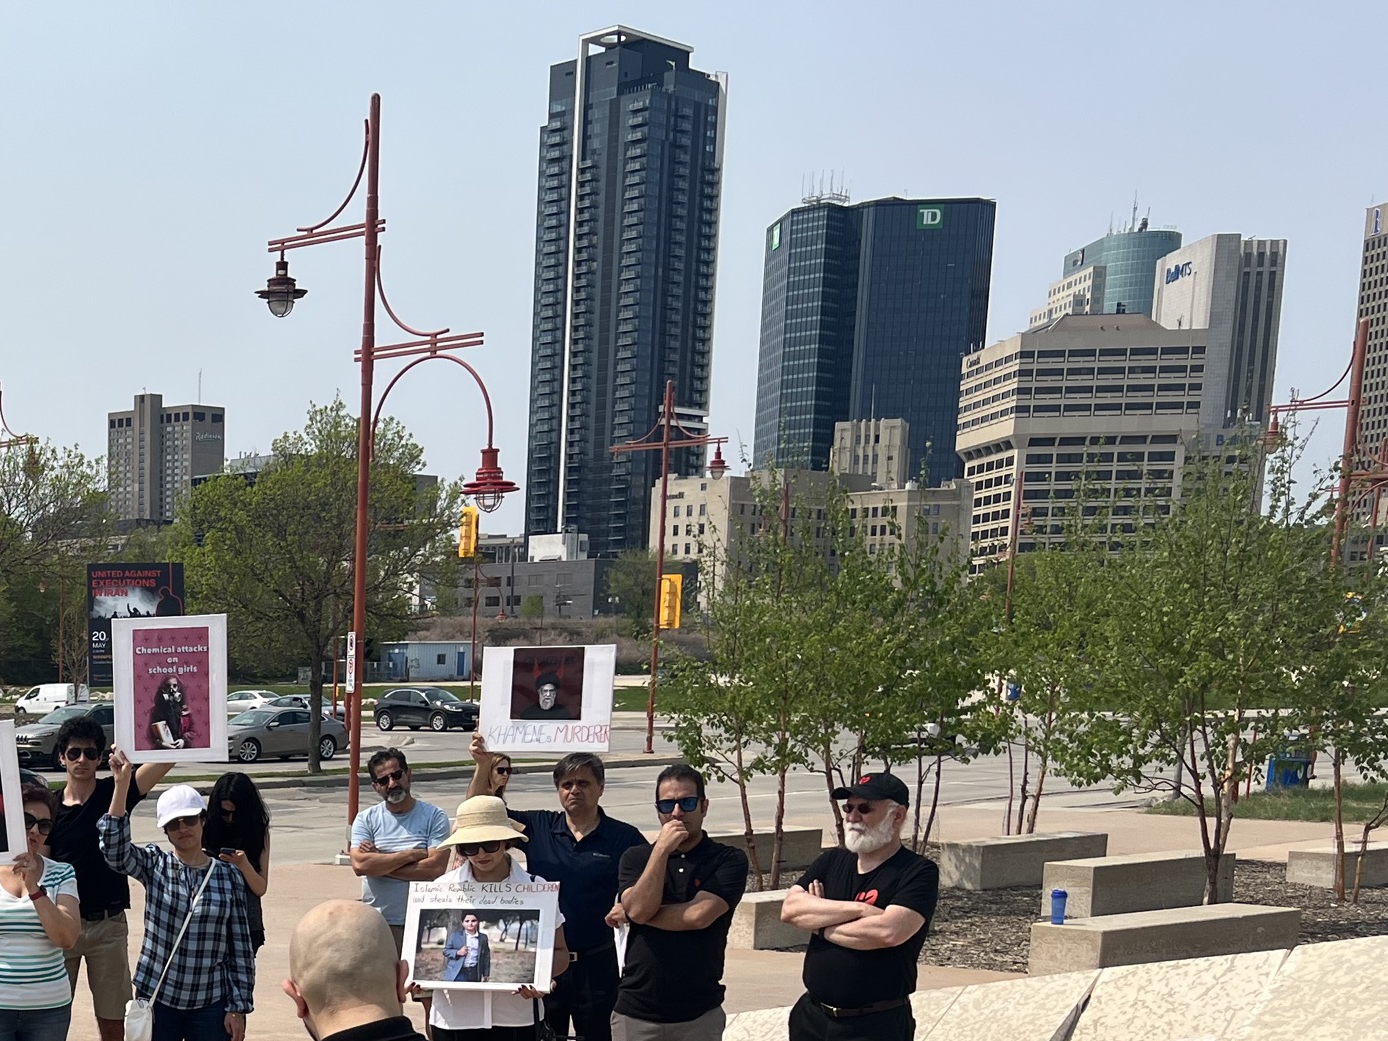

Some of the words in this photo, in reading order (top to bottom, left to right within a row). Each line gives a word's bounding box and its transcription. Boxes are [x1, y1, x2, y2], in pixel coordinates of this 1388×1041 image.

[919, 209, 941, 224] TD
[92, 570, 123, 578] UNITED
[124, 570, 162, 578] AGAINST
[92, 579, 156, 588] EXECUTIONS
[92, 588, 102, 596] IN
[104, 588, 129, 596] IRAN
[92, 631, 107, 640] 20
[135, 646, 175, 655] Chemical
[176, 644, 208, 653] attacks
[148, 666, 176, 674] school
[178, 665, 198, 674] girls
[414, 883, 444, 892] Islamic
[482, 884, 512, 893] KILLS
[430, 895, 452, 903] steals
[458, 895, 475, 904] their
[478, 895, 497, 904] dead
[500, 896, 524, 905] bodies
